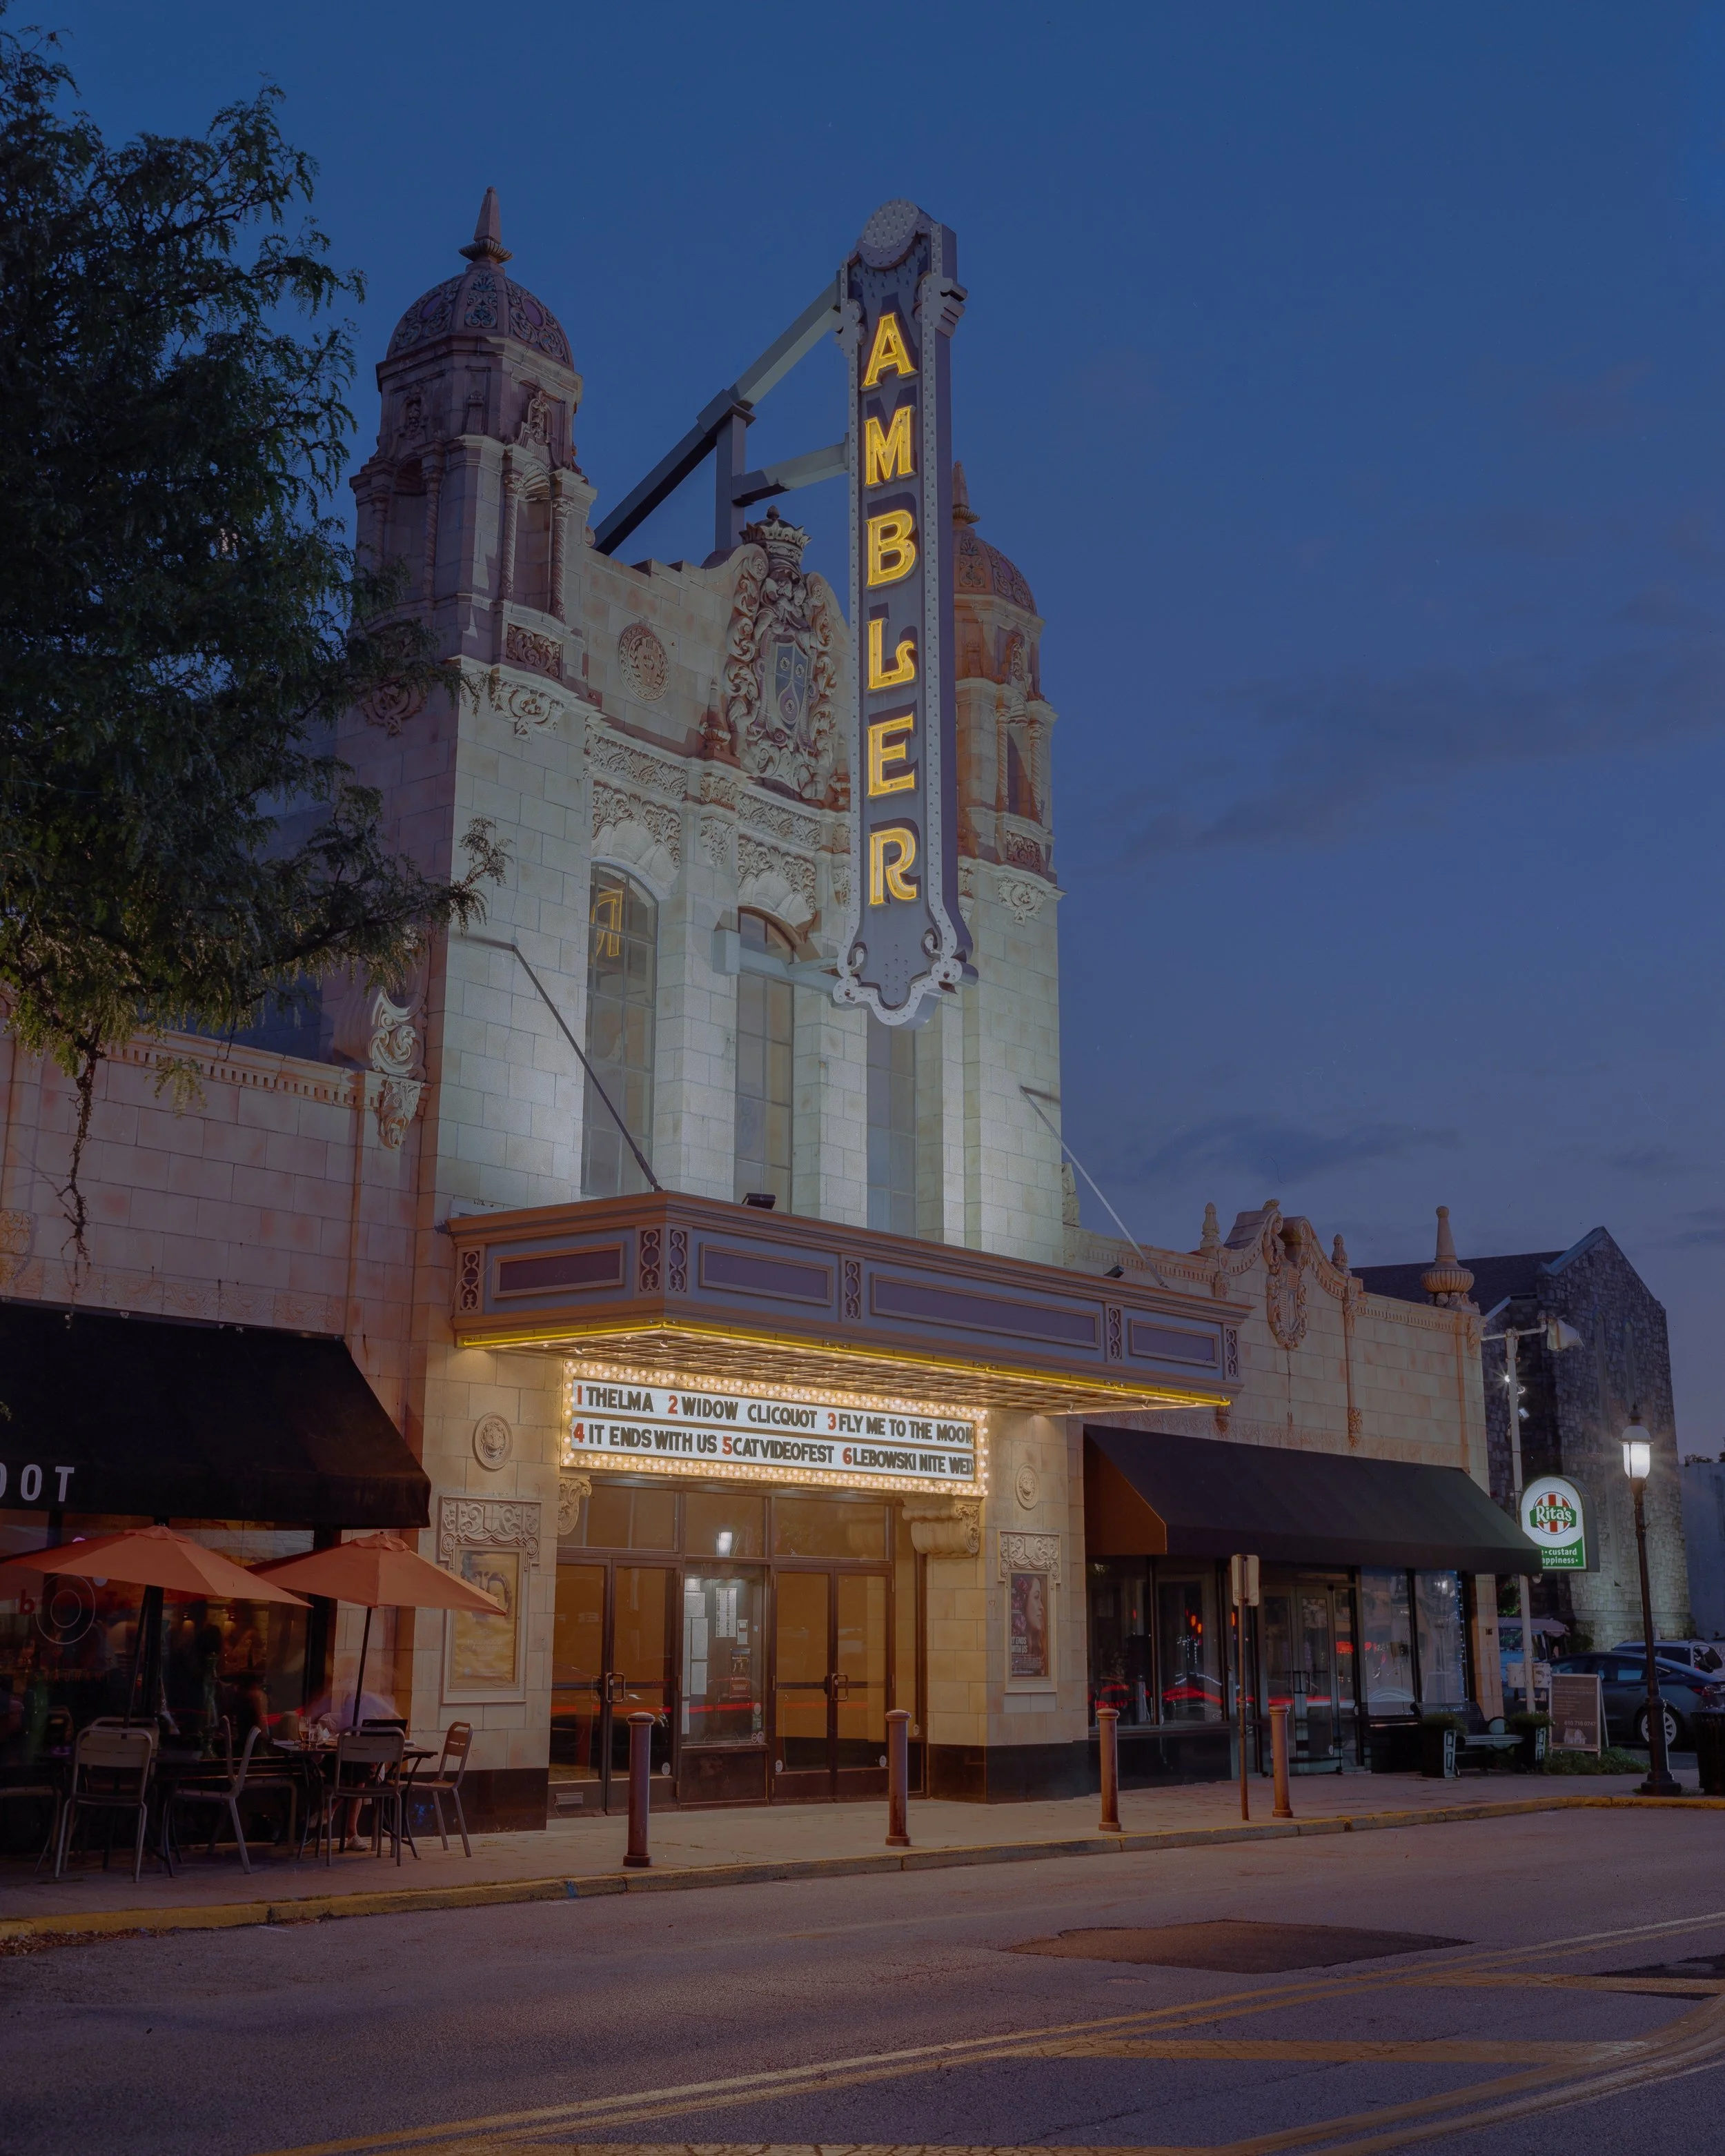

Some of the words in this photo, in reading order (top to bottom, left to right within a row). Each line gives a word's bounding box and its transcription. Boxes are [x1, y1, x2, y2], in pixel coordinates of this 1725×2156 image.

[860, 312, 920, 907] AMBLER
[586, 1386, 654, 1412] THELMA
[667, 1395, 678, 1414] 2
[681, 1396, 738, 1420] WIDOW
[747, 1404, 818, 1429] CLICQUOT
[827, 1412, 836, 1431] 3
[838, 1413, 864, 1433] FLY
[866, 1416, 886, 1436] ME
[889, 1418, 907, 1438] TO
[908, 1419, 933, 1441] THE
[936, 1423, 974, 1444] MOON
[573, 1423, 584, 1443] 4
[589, 1424, 604, 1444] IT
[609, 1425, 652, 1448] ENDS
[653, 1430, 693, 1452] WITH
[697, 1434, 717, 1454] US
[721, 1436, 733, 1455] 5
[733, 1437, 834, 1463] CATVIDEOFEST
[842, 1447, 853, 1465] 6
[853, 1447, 916, 1470] LEBOWSKI
[919, 1454, 946, 1474] NITE
[949, 1456, 974, 1475] WED
[1535, 1505, 1573, 1523] Rita's
[1542, 1556, 1575, 1565] appiness
